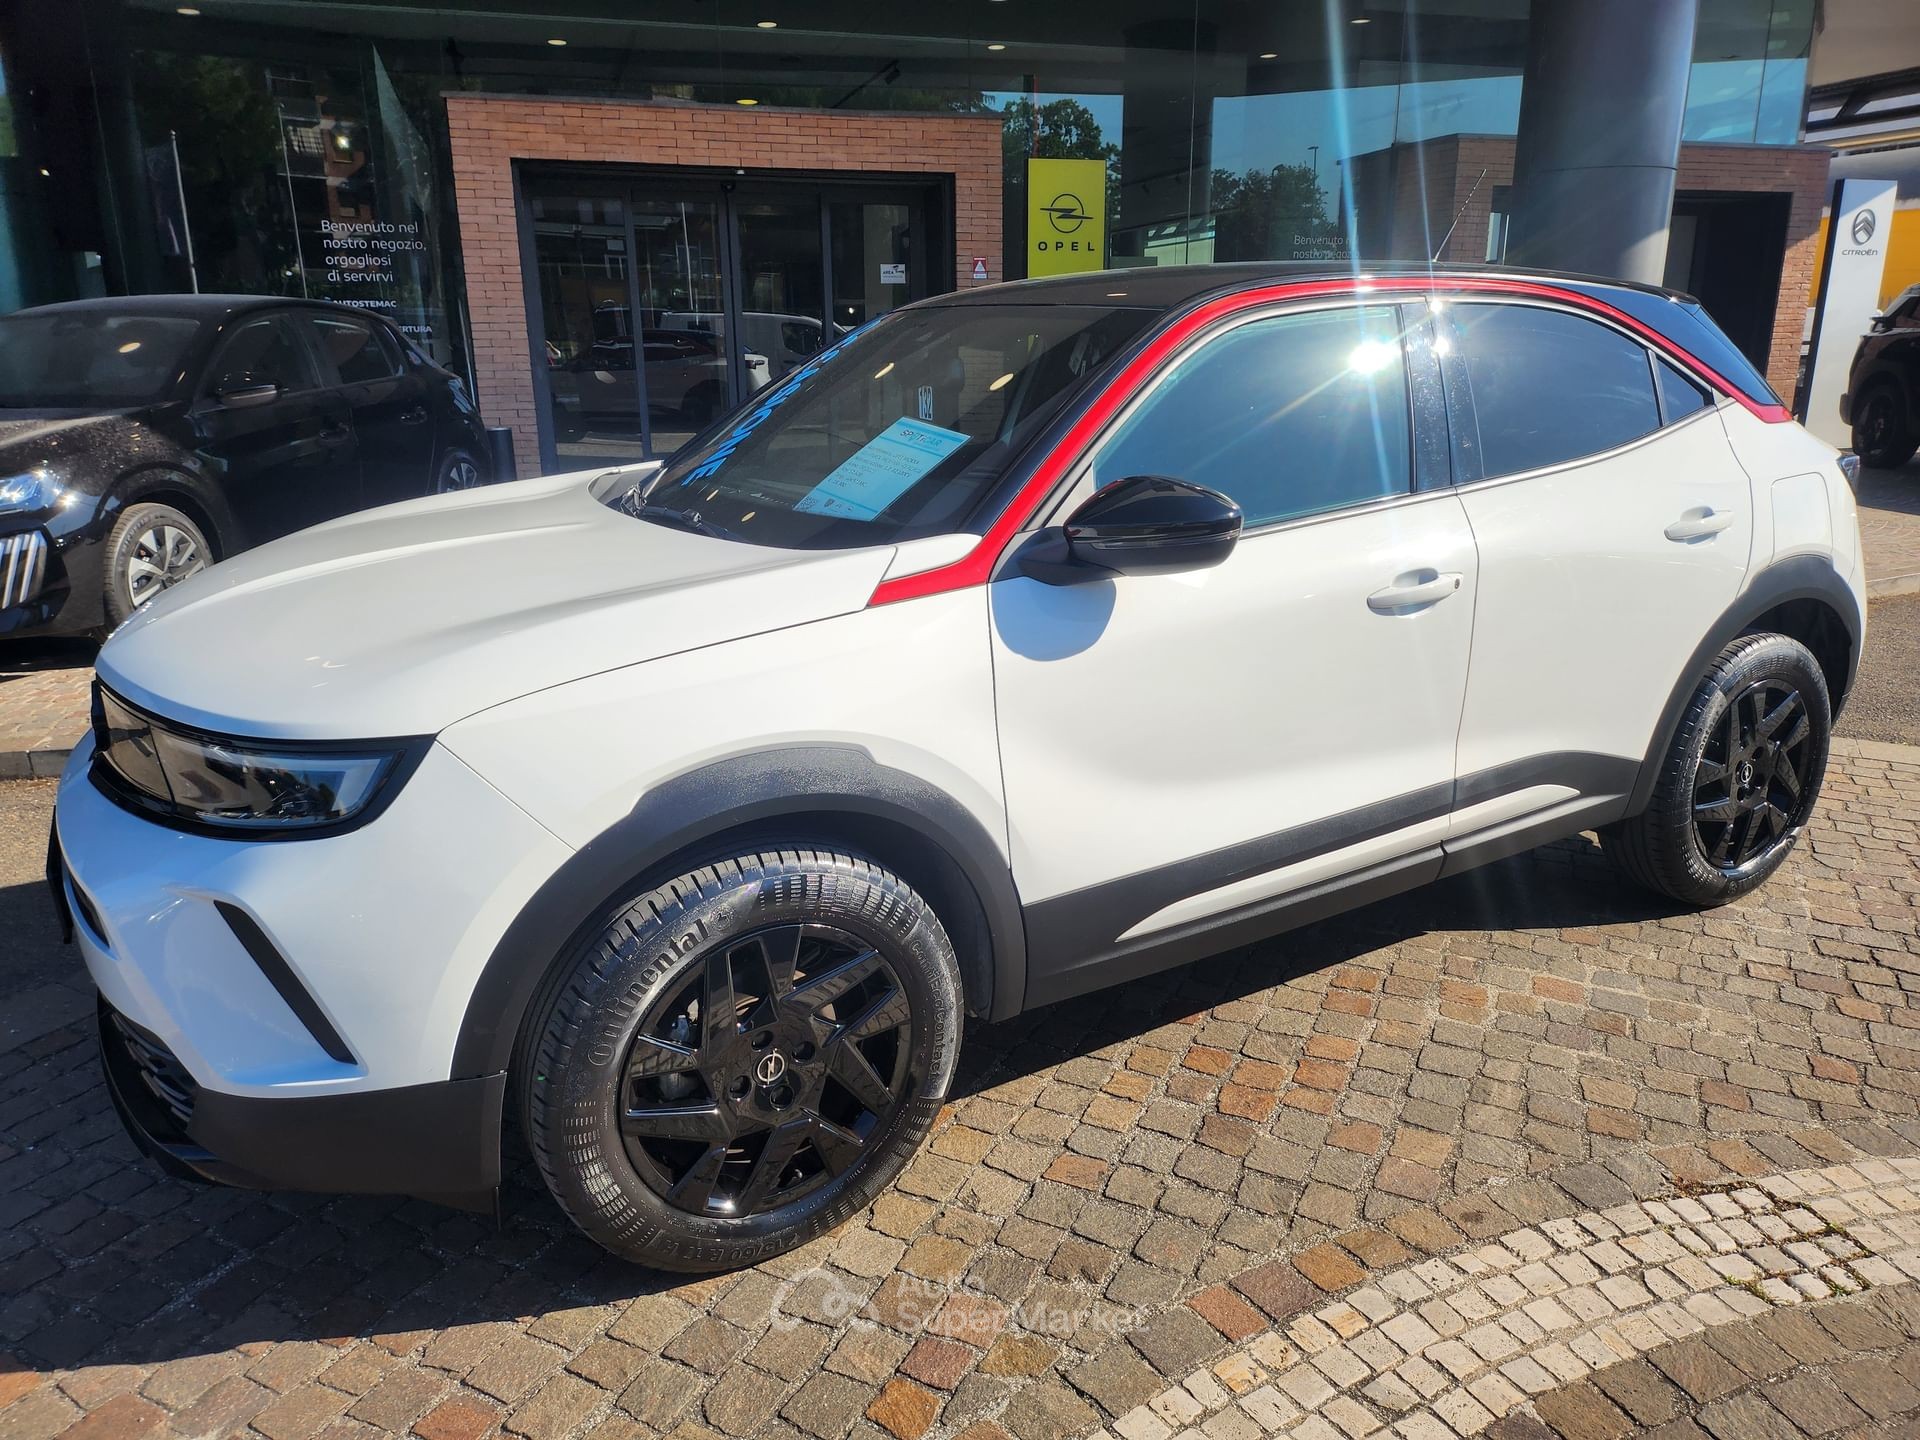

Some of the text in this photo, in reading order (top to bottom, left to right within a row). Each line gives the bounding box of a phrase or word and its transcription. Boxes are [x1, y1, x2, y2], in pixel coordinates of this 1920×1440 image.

[321, 219, 419, 233] Benvenuto nel
[323, 238, 367, 249] nostro
[1294, 234, 1344, 245] Benvenuto
[1038, 241, 1095, 252] OPEL
[325, 253, 391, 268] orgogliosi
[327, 269, 393, 283] di servirvi
